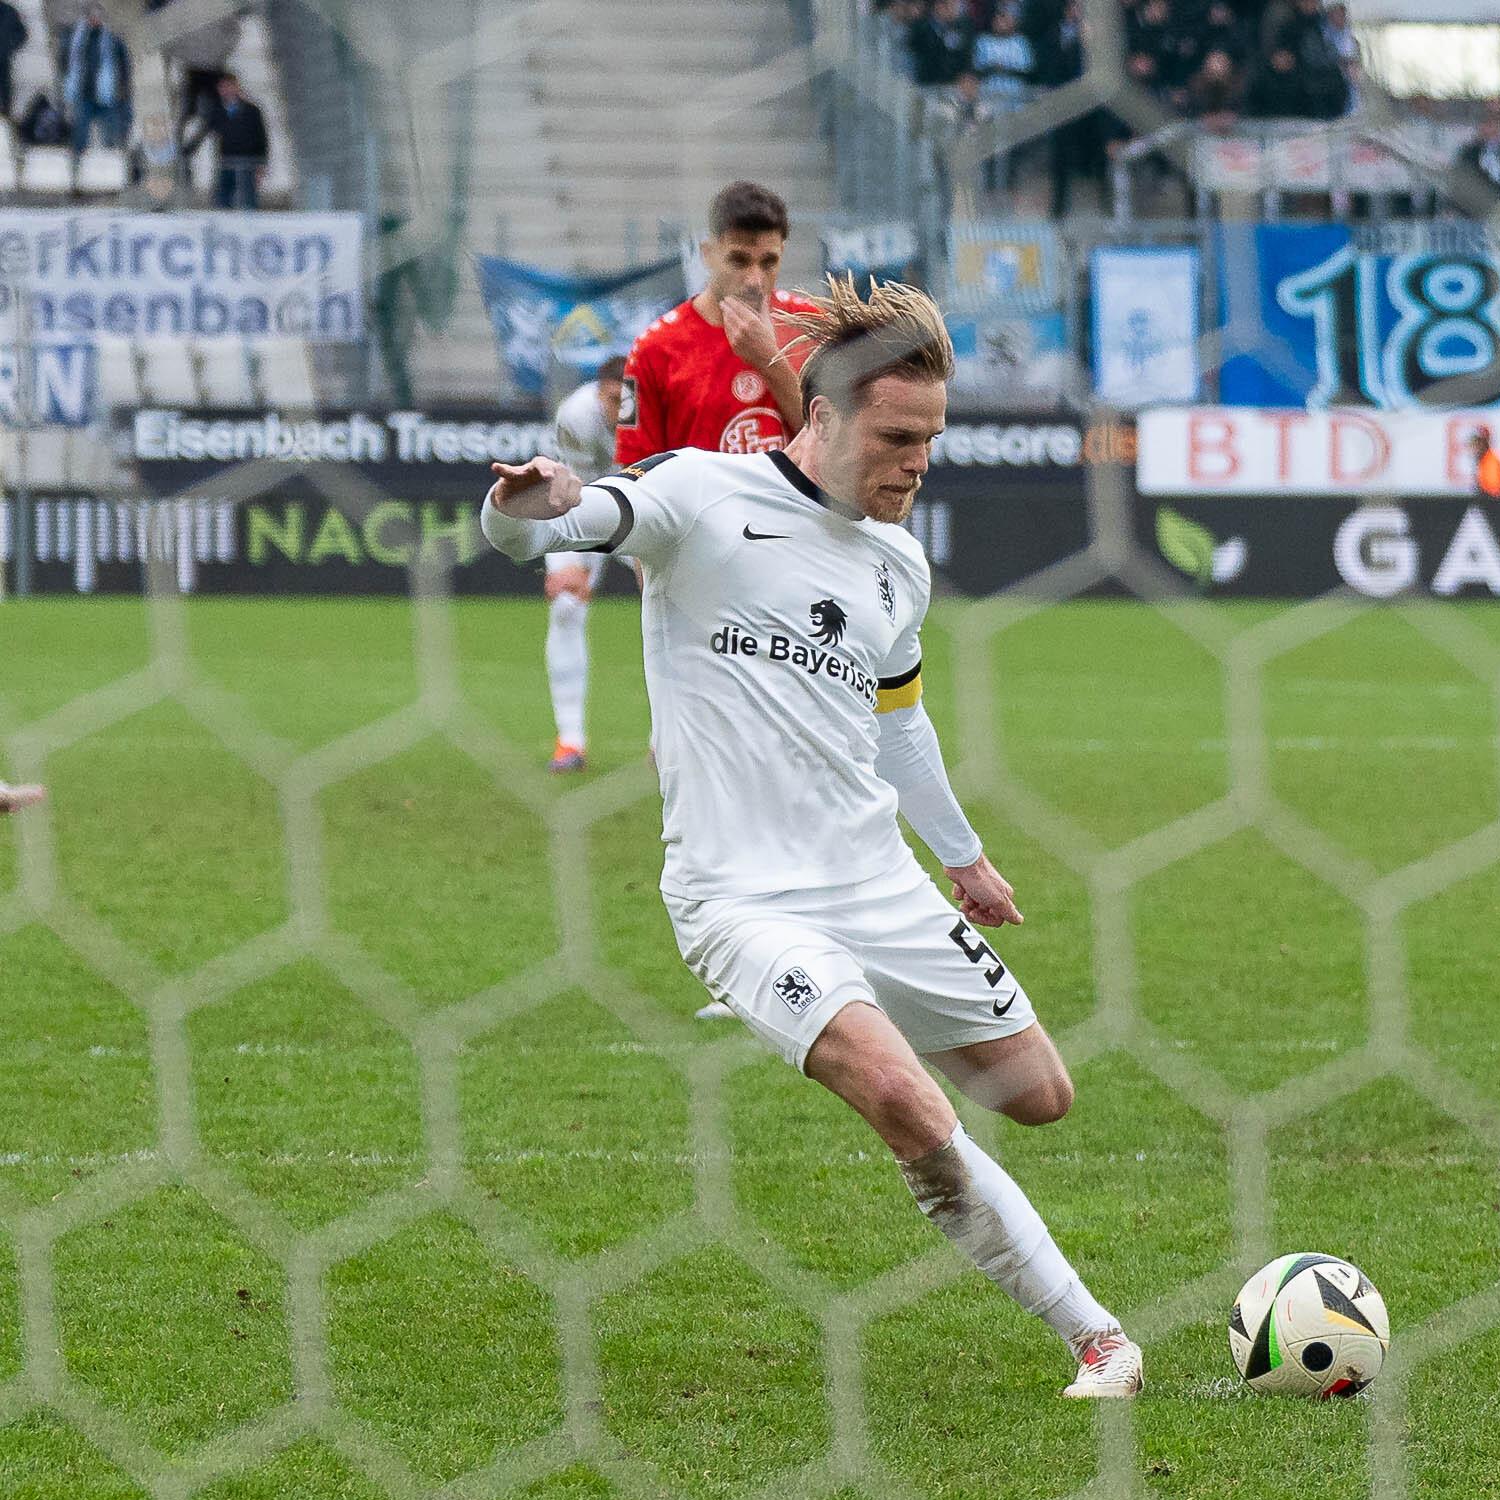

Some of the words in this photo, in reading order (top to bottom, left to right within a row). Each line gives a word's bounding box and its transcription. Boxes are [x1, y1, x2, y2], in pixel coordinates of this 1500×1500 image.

[133, 410, 382, 463] Eisenbach
[1187, 412, 1392, 484] BTD
[246, 502, 478, 567] NACH
[710, 626, 758, 657] die
[947, 917, 1006, 989] 5
